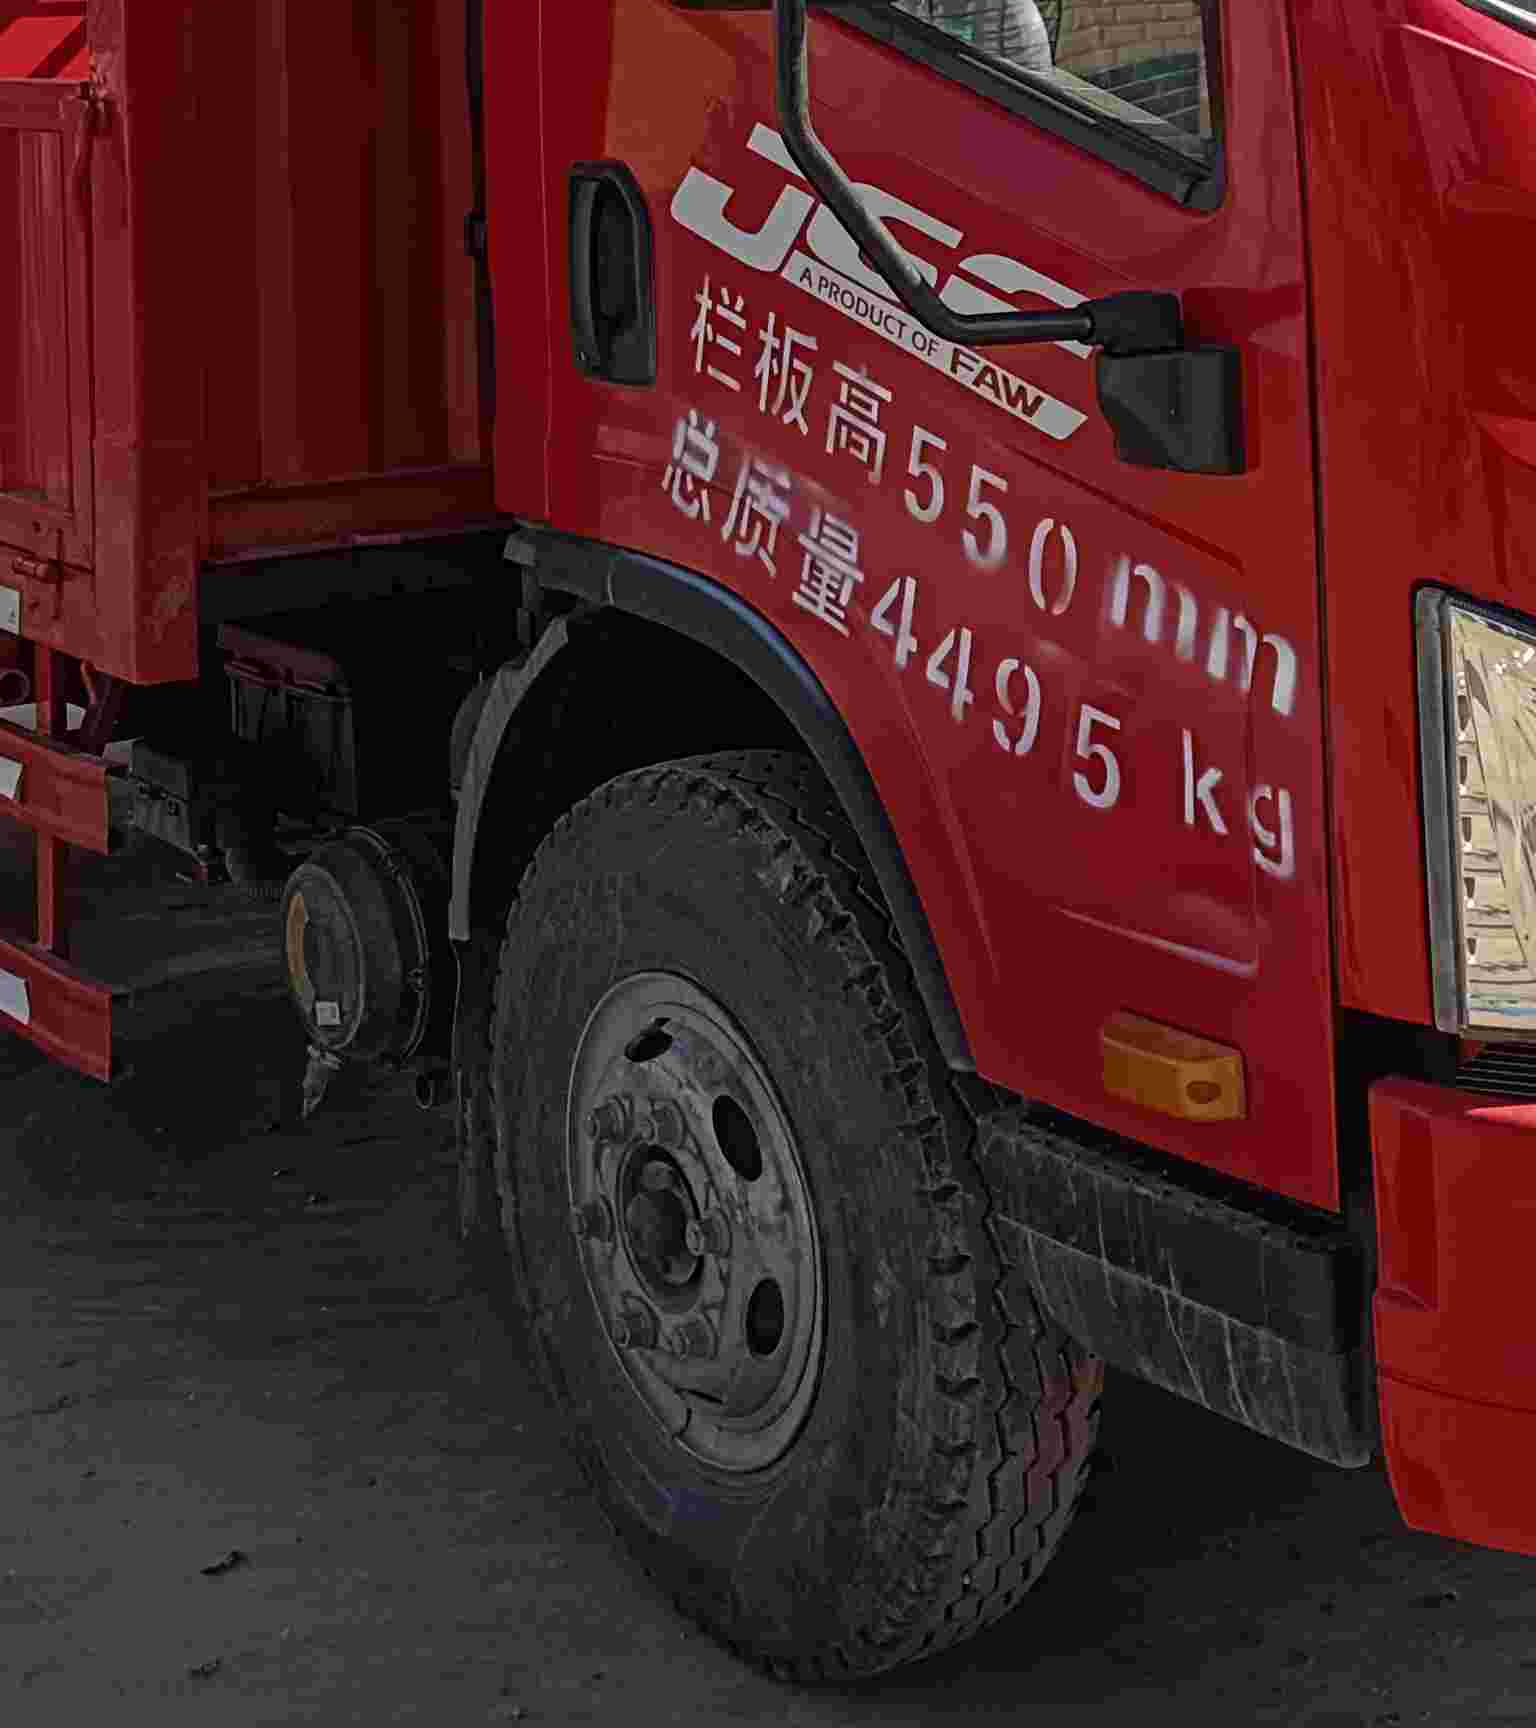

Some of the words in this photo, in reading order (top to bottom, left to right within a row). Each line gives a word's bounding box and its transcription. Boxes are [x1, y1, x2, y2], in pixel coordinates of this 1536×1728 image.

[798, 266, 813, 287] A
[816, 275, 908, 339] PRODUCT
[910, 329, 940, 357] OF
[948, 347, 1047, 419] FAW
